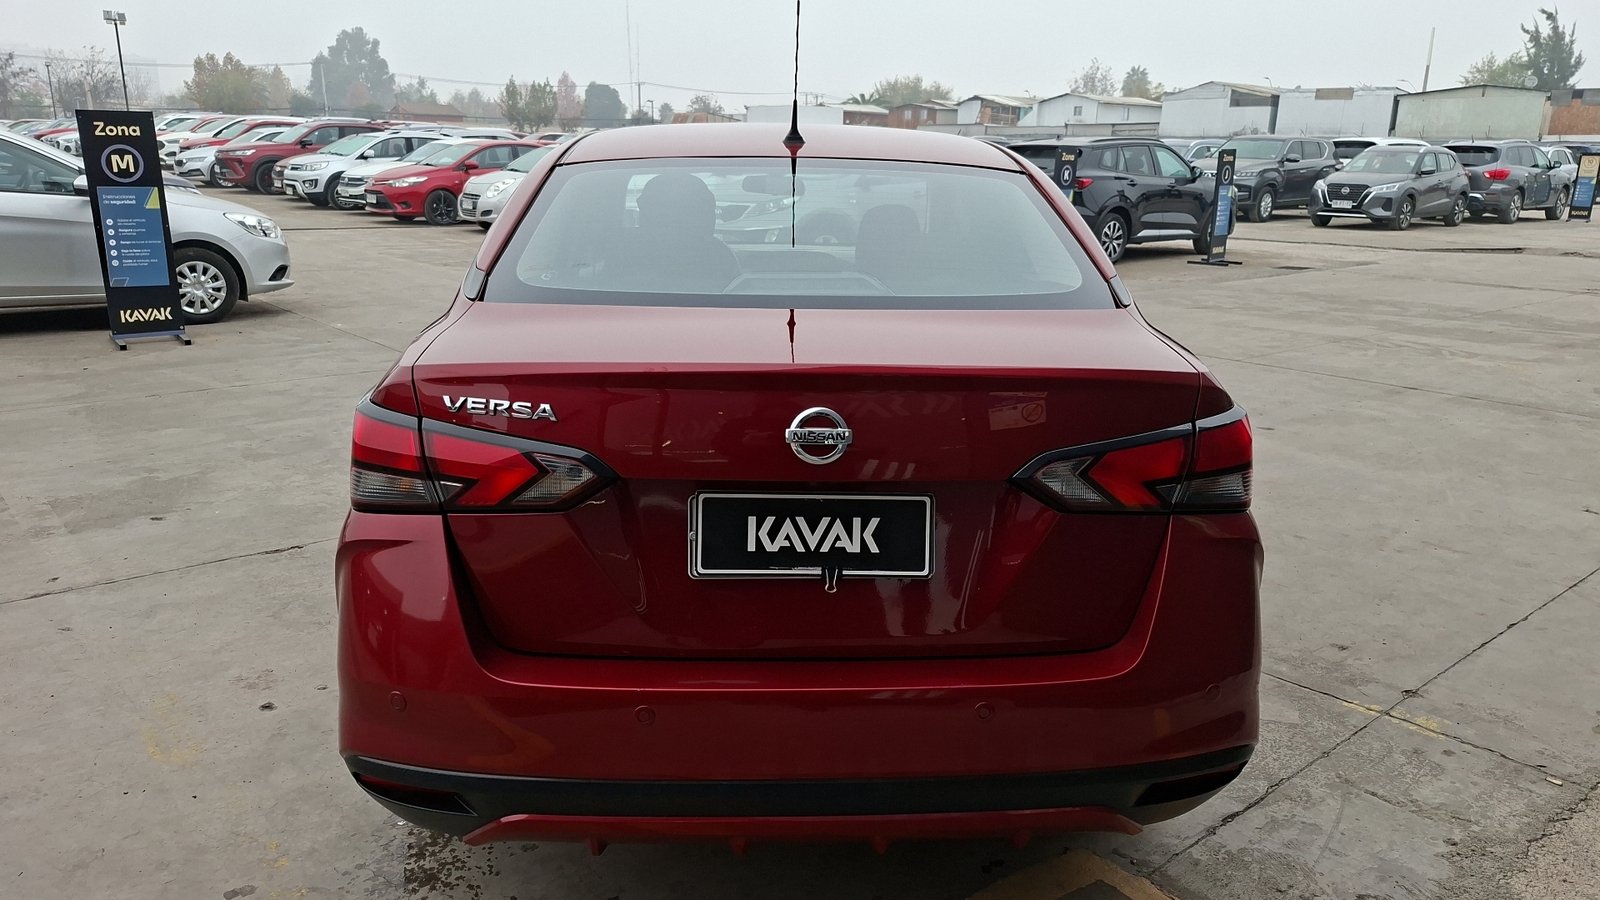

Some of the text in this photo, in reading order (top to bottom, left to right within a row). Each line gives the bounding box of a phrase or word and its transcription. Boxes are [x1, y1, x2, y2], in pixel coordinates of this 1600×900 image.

[93, 121, 141, 137] Zona
[110, 154, 135, 173] M
[1061, 152, 1075, 161] Zona
[1063, 169, 1070, 181] K
[1224, 169, 1229, 180] J
[119, 306, 173, 324] KAVAK
[442, 395, 558, 422] VERSA
[792, 431, 846, 441] NISSAN
[747, 515, 881, 554] KAVAK
